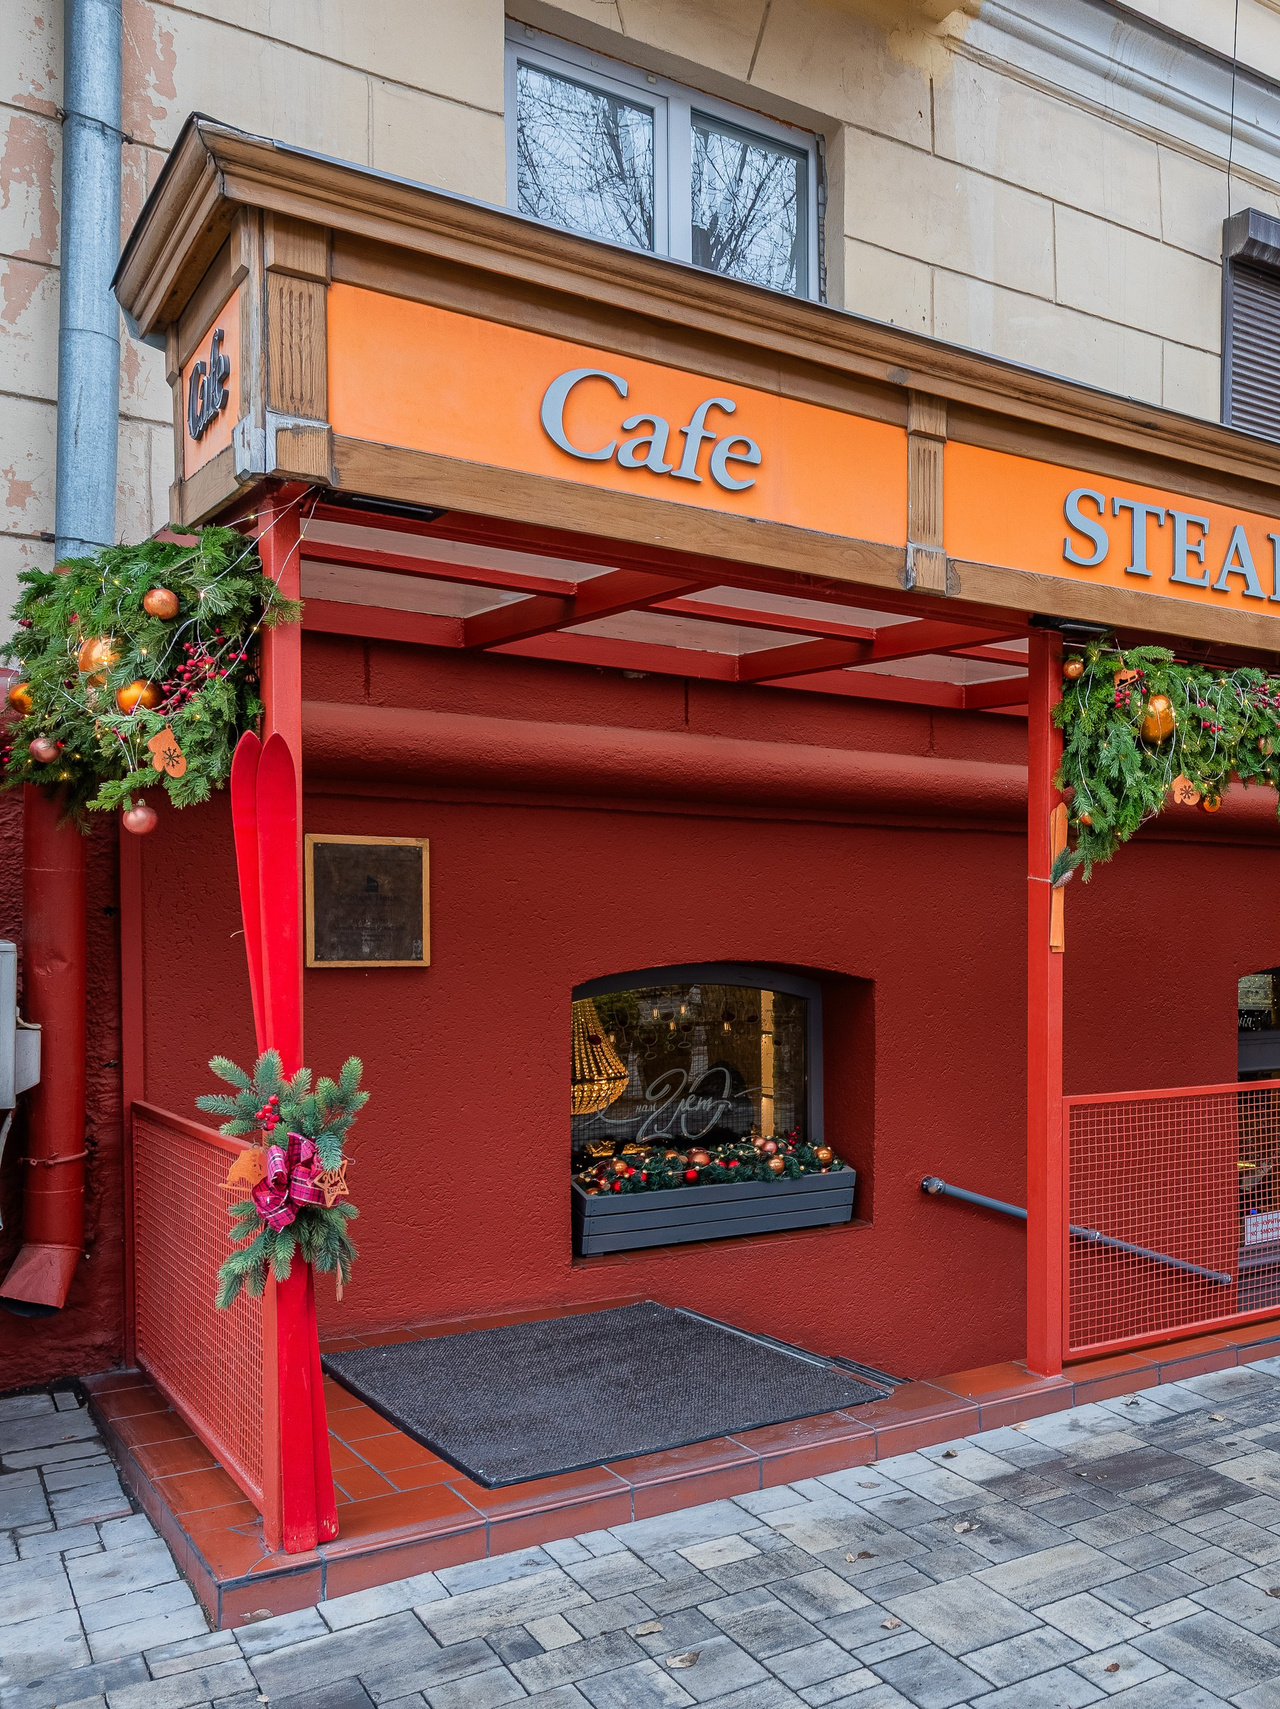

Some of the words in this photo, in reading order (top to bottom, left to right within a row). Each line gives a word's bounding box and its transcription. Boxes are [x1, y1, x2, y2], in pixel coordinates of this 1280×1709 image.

[188, 328, 231, 441] Cafe
[539, 366, 763, 493] Cafe
[635, 1102, 658, 1113] нам
[636, 1067, 732, 1144] 20
